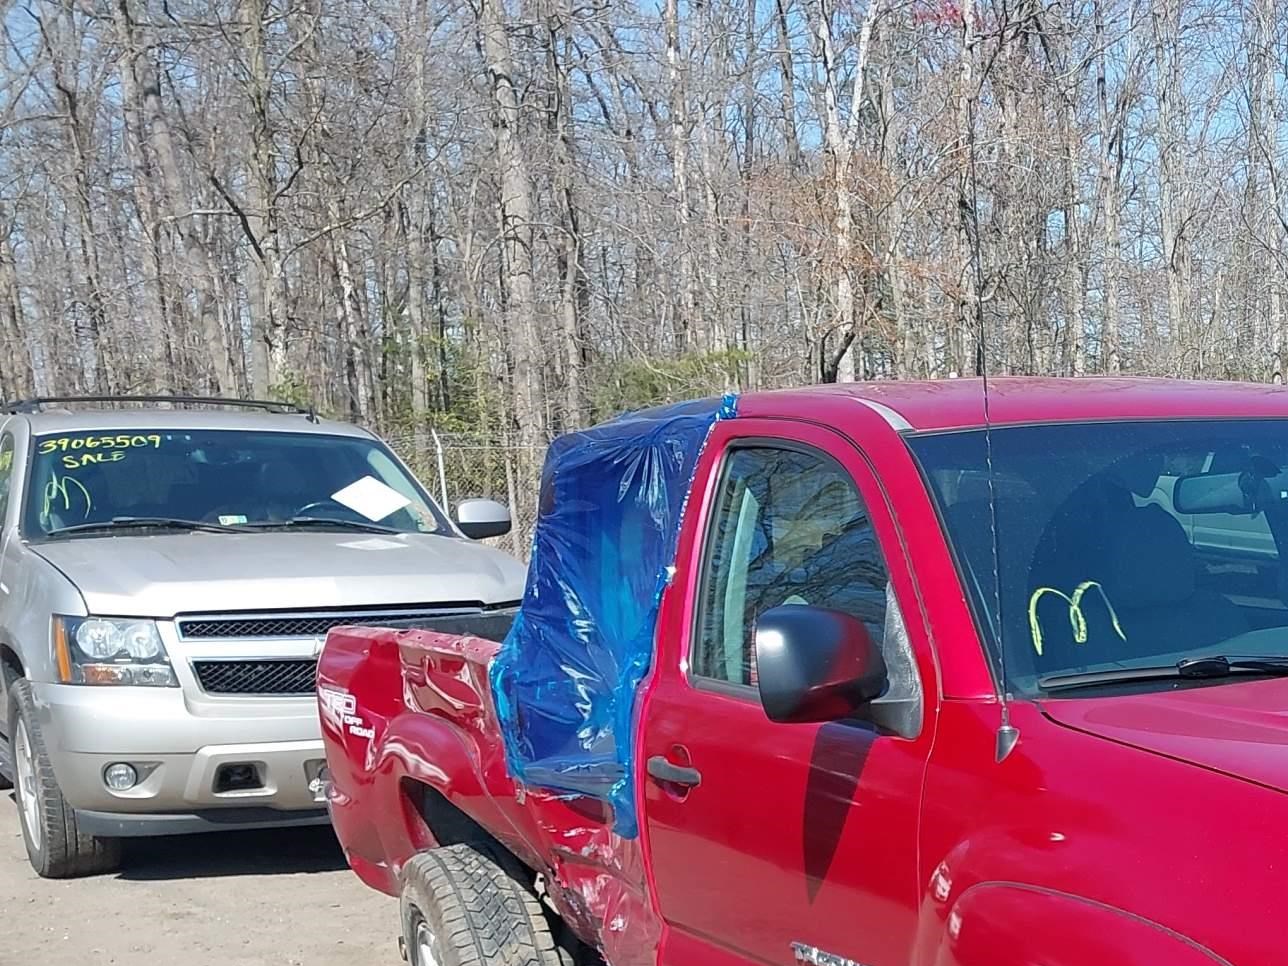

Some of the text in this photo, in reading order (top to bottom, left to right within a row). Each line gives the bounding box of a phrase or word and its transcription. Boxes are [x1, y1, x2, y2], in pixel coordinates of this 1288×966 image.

[39, 435, 161, 454] 39065509
[62, 451, 126, 469] SALE
[349, 726, 376, 739] ROAD
